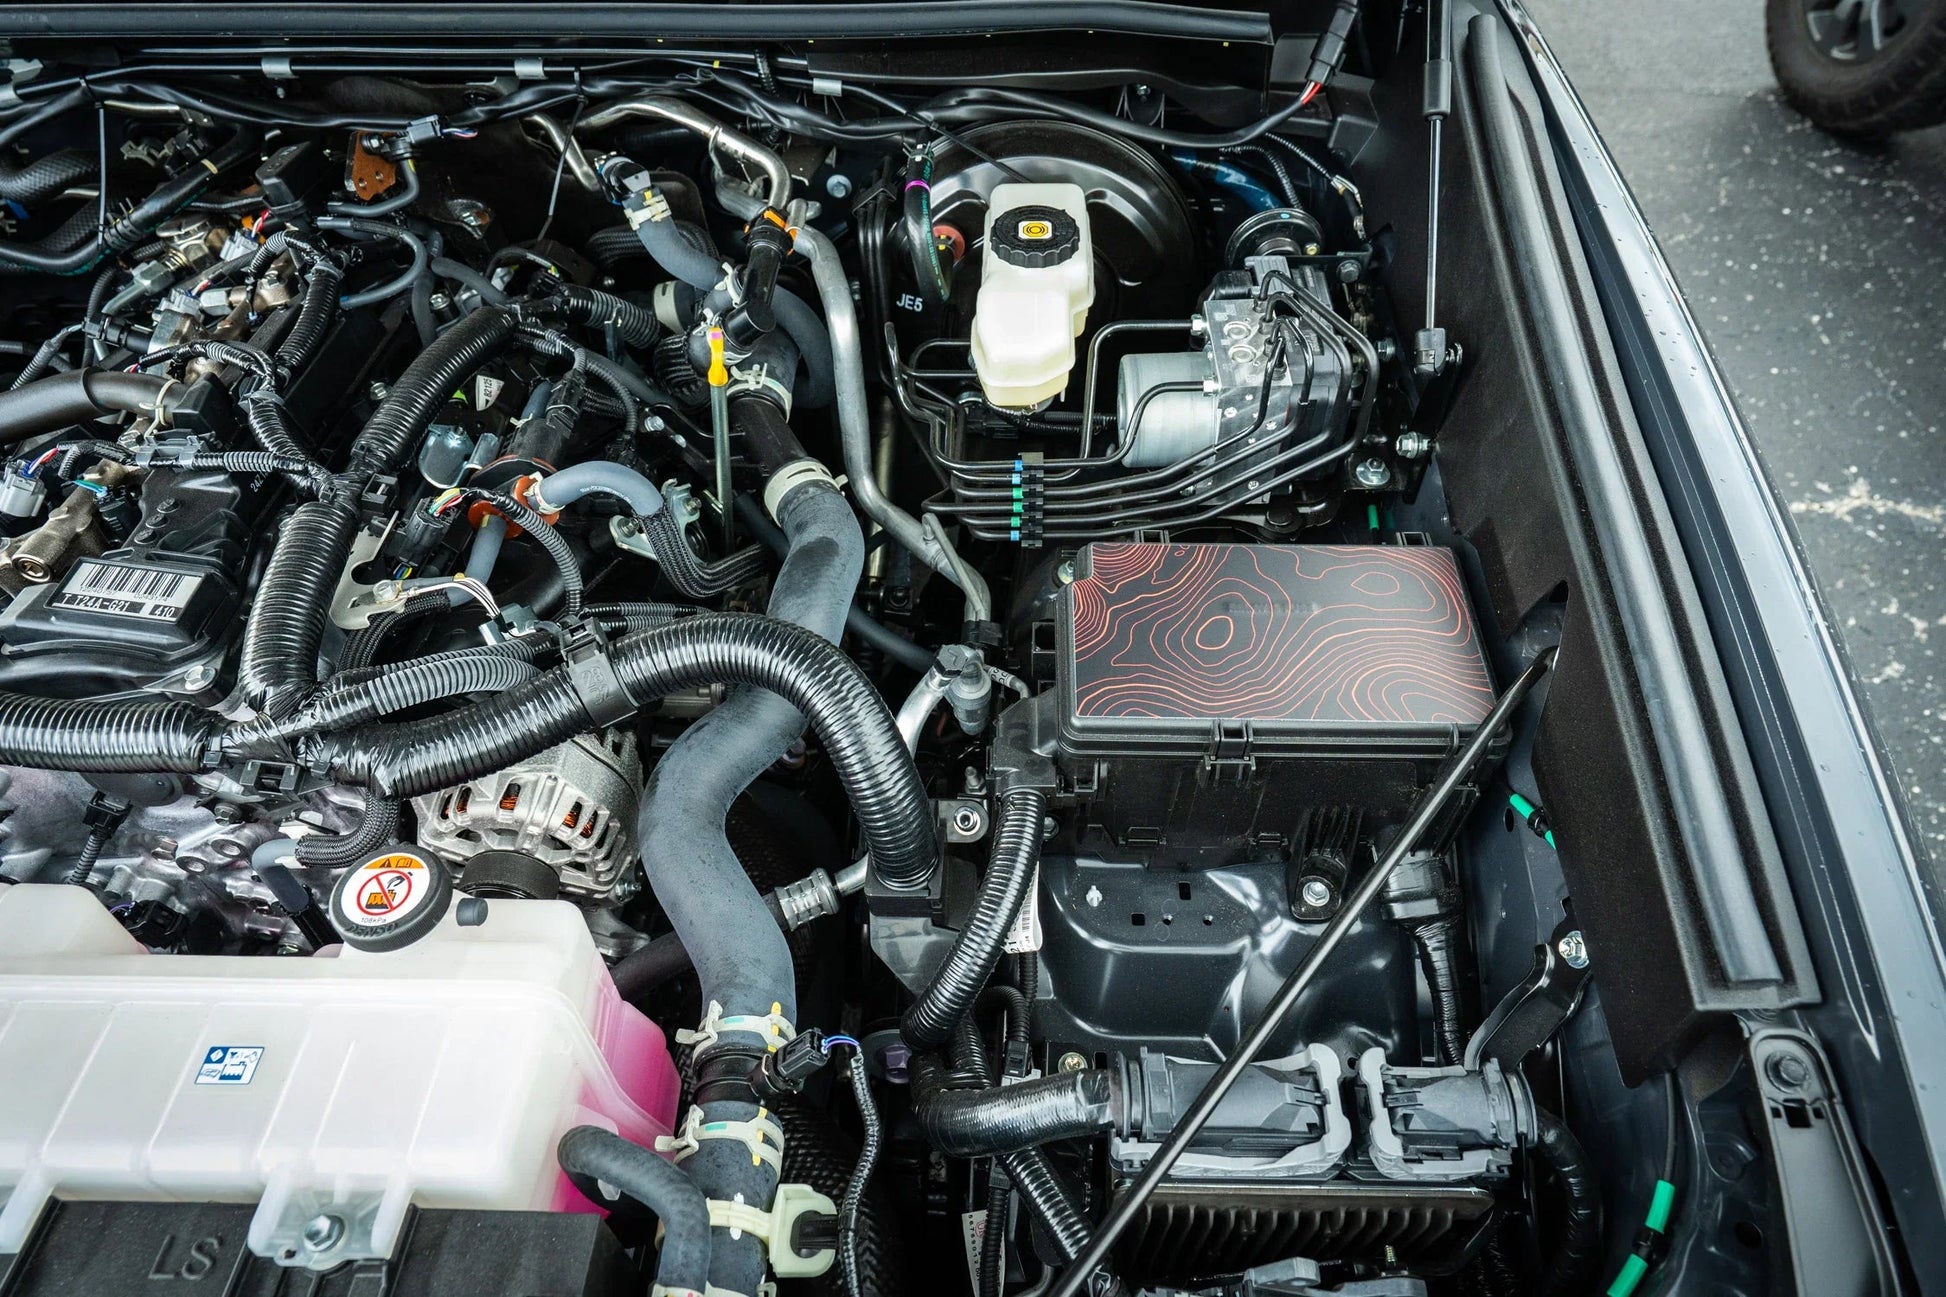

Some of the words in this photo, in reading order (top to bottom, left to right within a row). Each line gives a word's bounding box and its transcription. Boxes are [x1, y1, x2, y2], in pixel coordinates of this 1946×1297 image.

[896, 293, 923, 312] JE5
[73, 595, 131, 613] T24A-G21
[154, 607, 175, 618] 410
[344, 922, 400, 938] DENSO
[148, 1234, 222, 1280] LS
